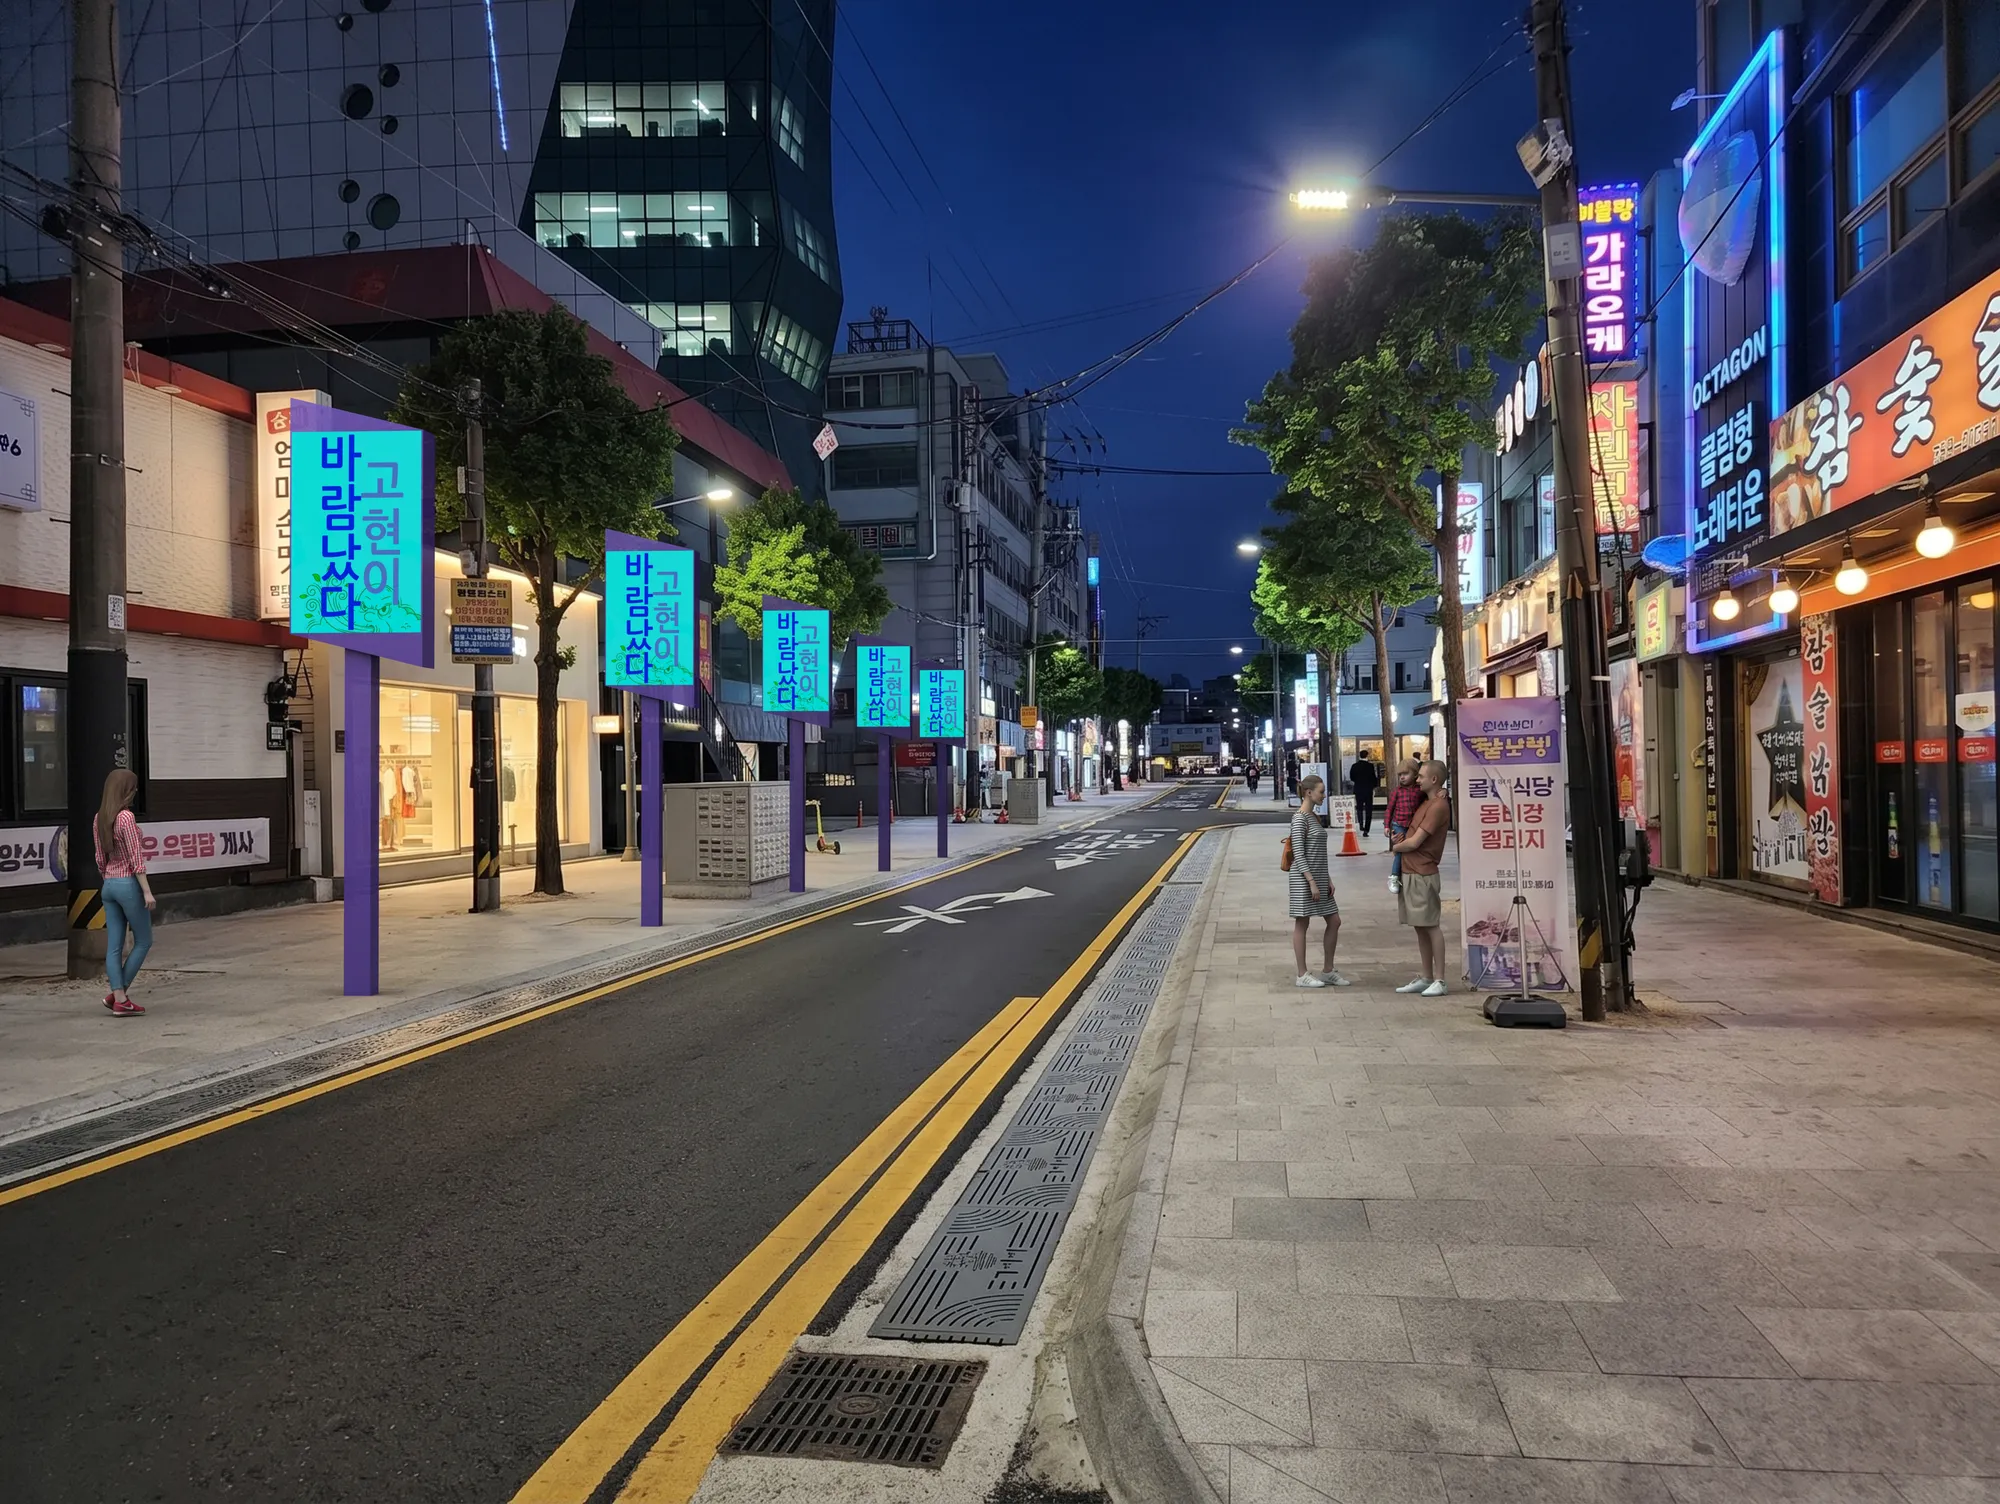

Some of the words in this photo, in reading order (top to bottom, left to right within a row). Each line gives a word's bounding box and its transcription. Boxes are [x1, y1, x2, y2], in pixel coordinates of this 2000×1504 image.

[1586, 232, 1625, 352] 가라오케
[1693, 325, 1765, 411] OCTAGON
[321, 434, 361, 630] 바람났다
[361, 462, 403, 605] 고현이
[626, 553, 653, 683] 바람났다
[653, 571, 681, 667] 고현이
[777, 612, 798, 710] 바람났다
[798, 625, 820, 698] 고현이
[869, 648, 886, 726] 바람났다
[885, 658, 903, 716] 고현이
[930, 671, 944, 736] 바람났다
[943, 680, 958, 728] 고현이
